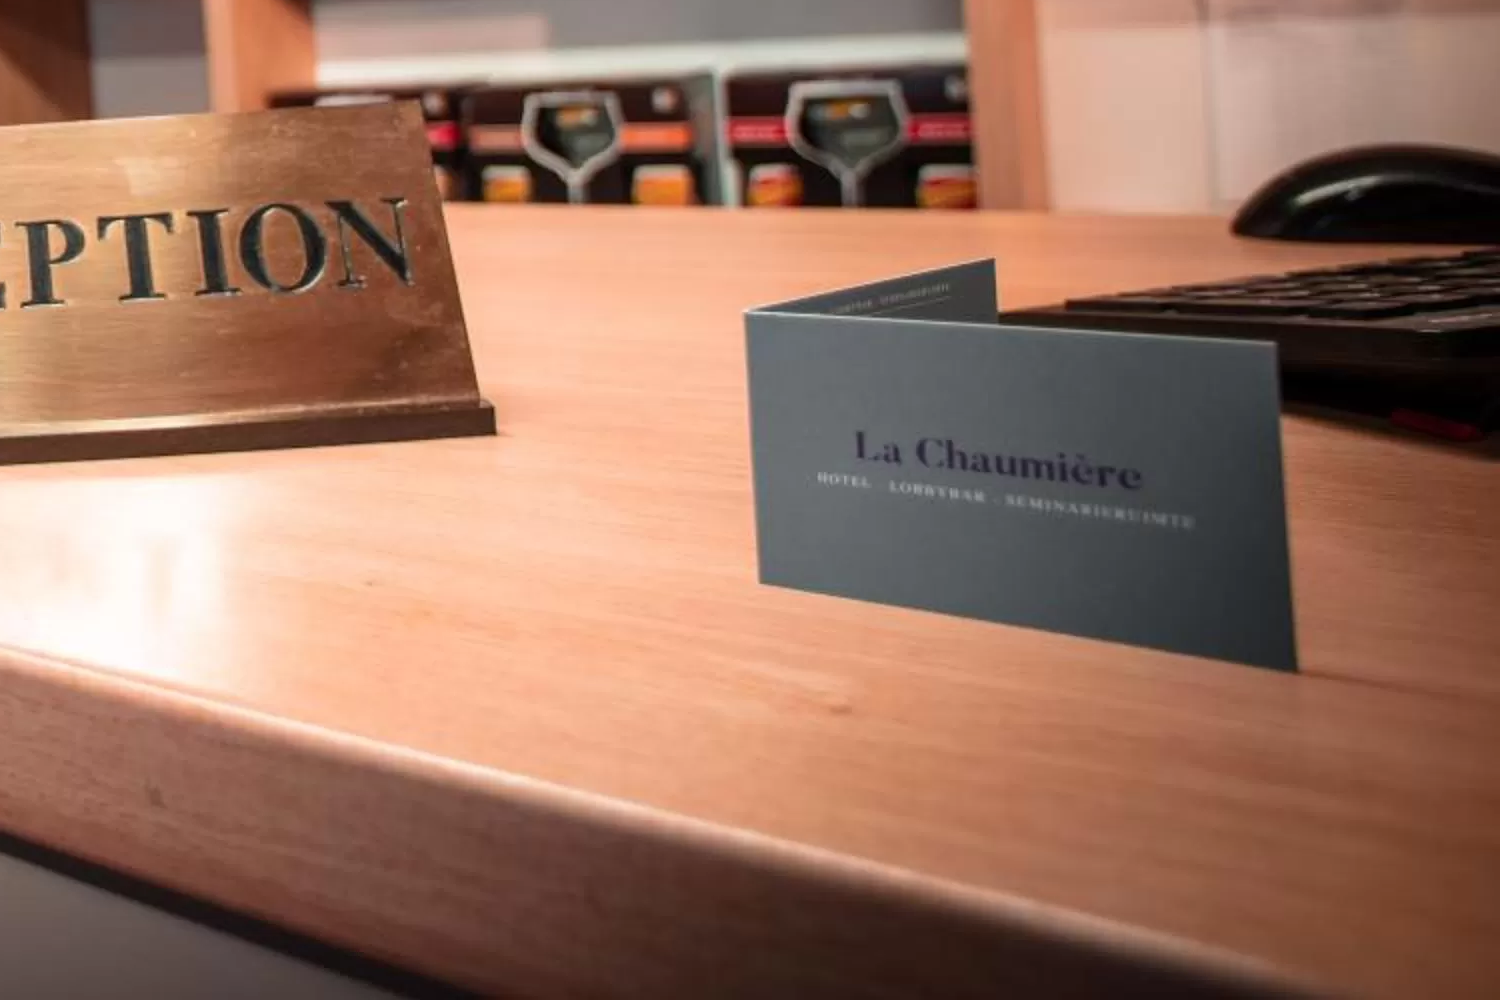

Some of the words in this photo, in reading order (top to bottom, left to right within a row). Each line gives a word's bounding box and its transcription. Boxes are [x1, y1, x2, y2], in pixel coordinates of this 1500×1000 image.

[855, 431, 902, 466] La
[915, 438, 1143, 490] Chaumière
[817, 471, 872, 489] HOTEL
